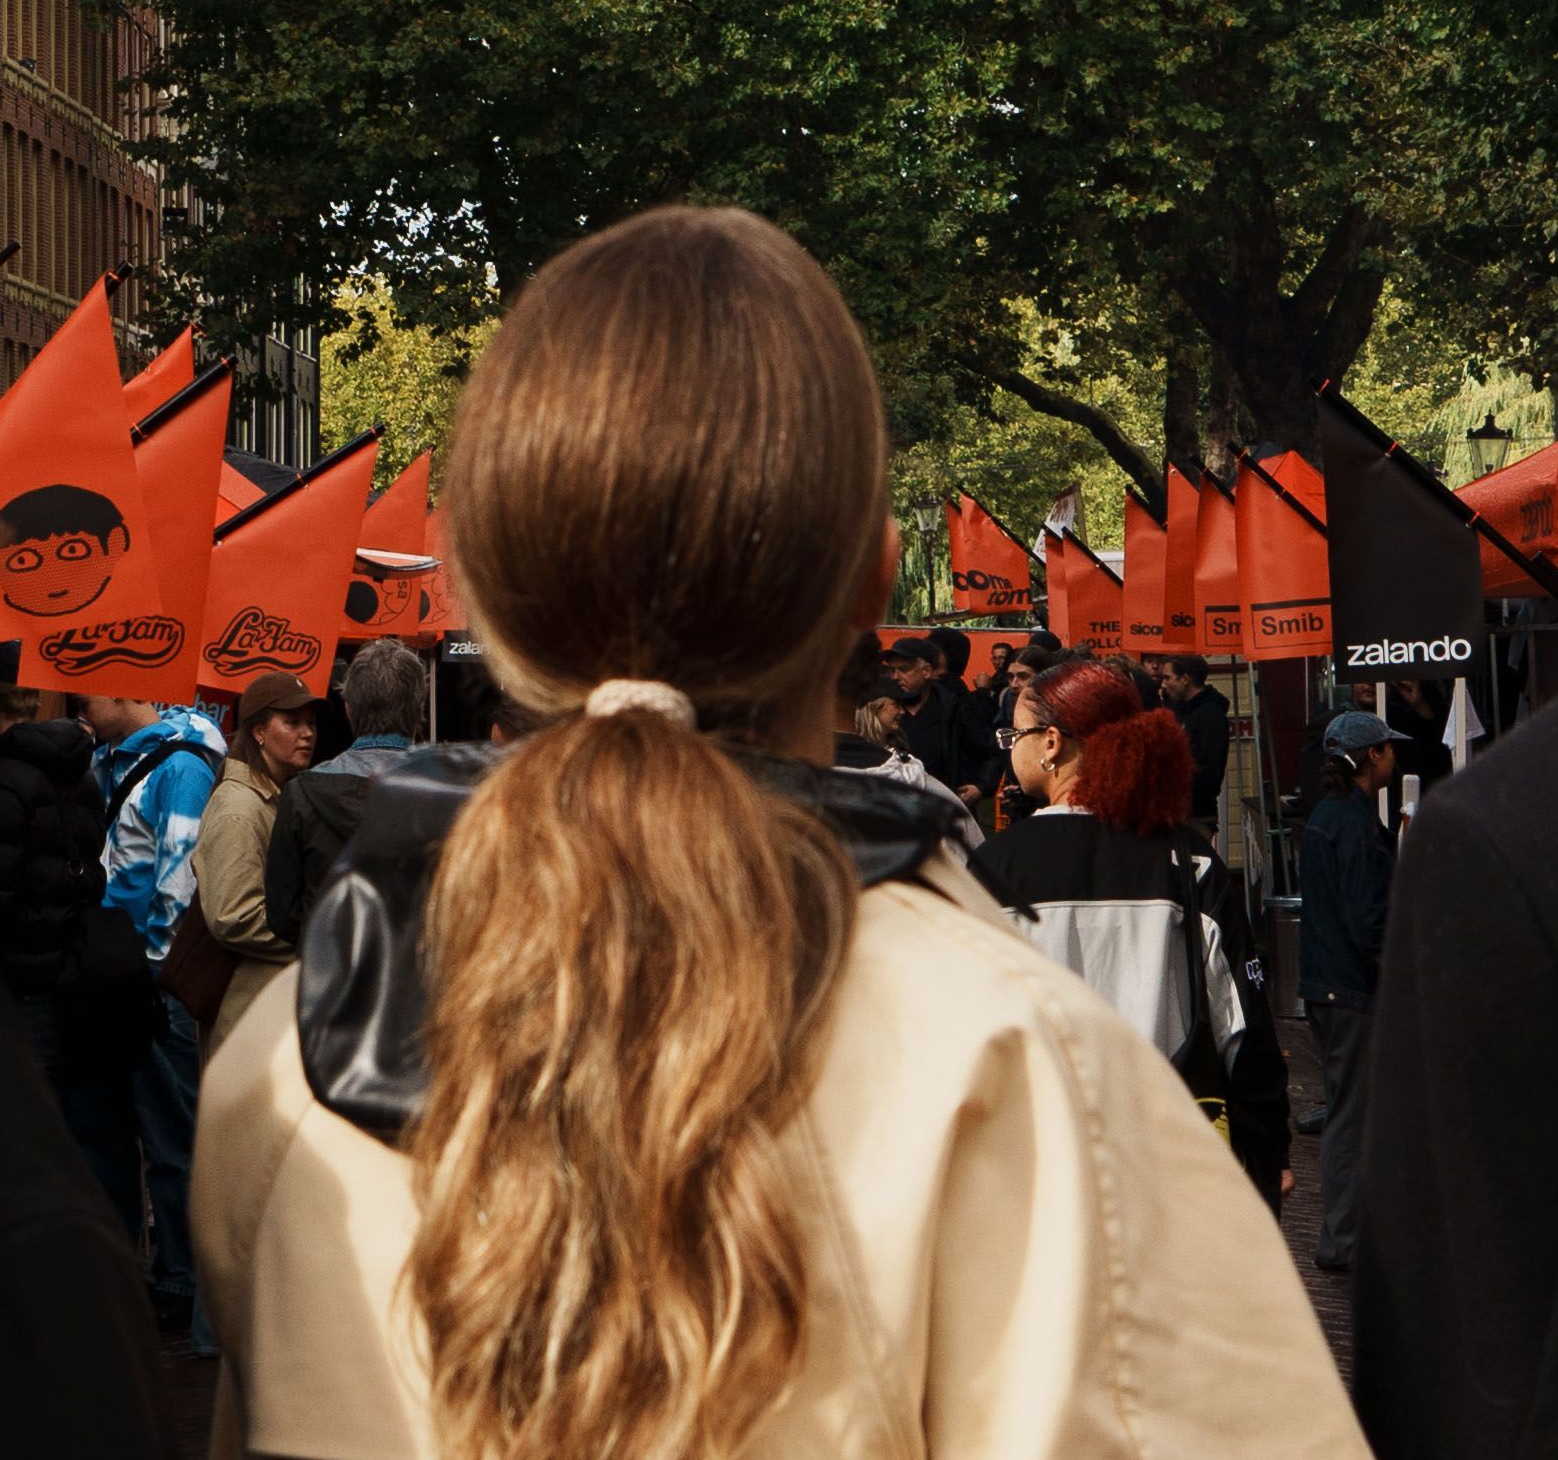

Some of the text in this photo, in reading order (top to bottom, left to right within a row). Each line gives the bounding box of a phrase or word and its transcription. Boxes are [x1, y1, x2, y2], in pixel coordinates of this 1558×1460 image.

[1089, 621, 1120, 633] THE
[1212, 617, 1241, 636] Sm
[1261, 612, 1324, 636] Smib
[1346, 635, 1472, 667] zalando
